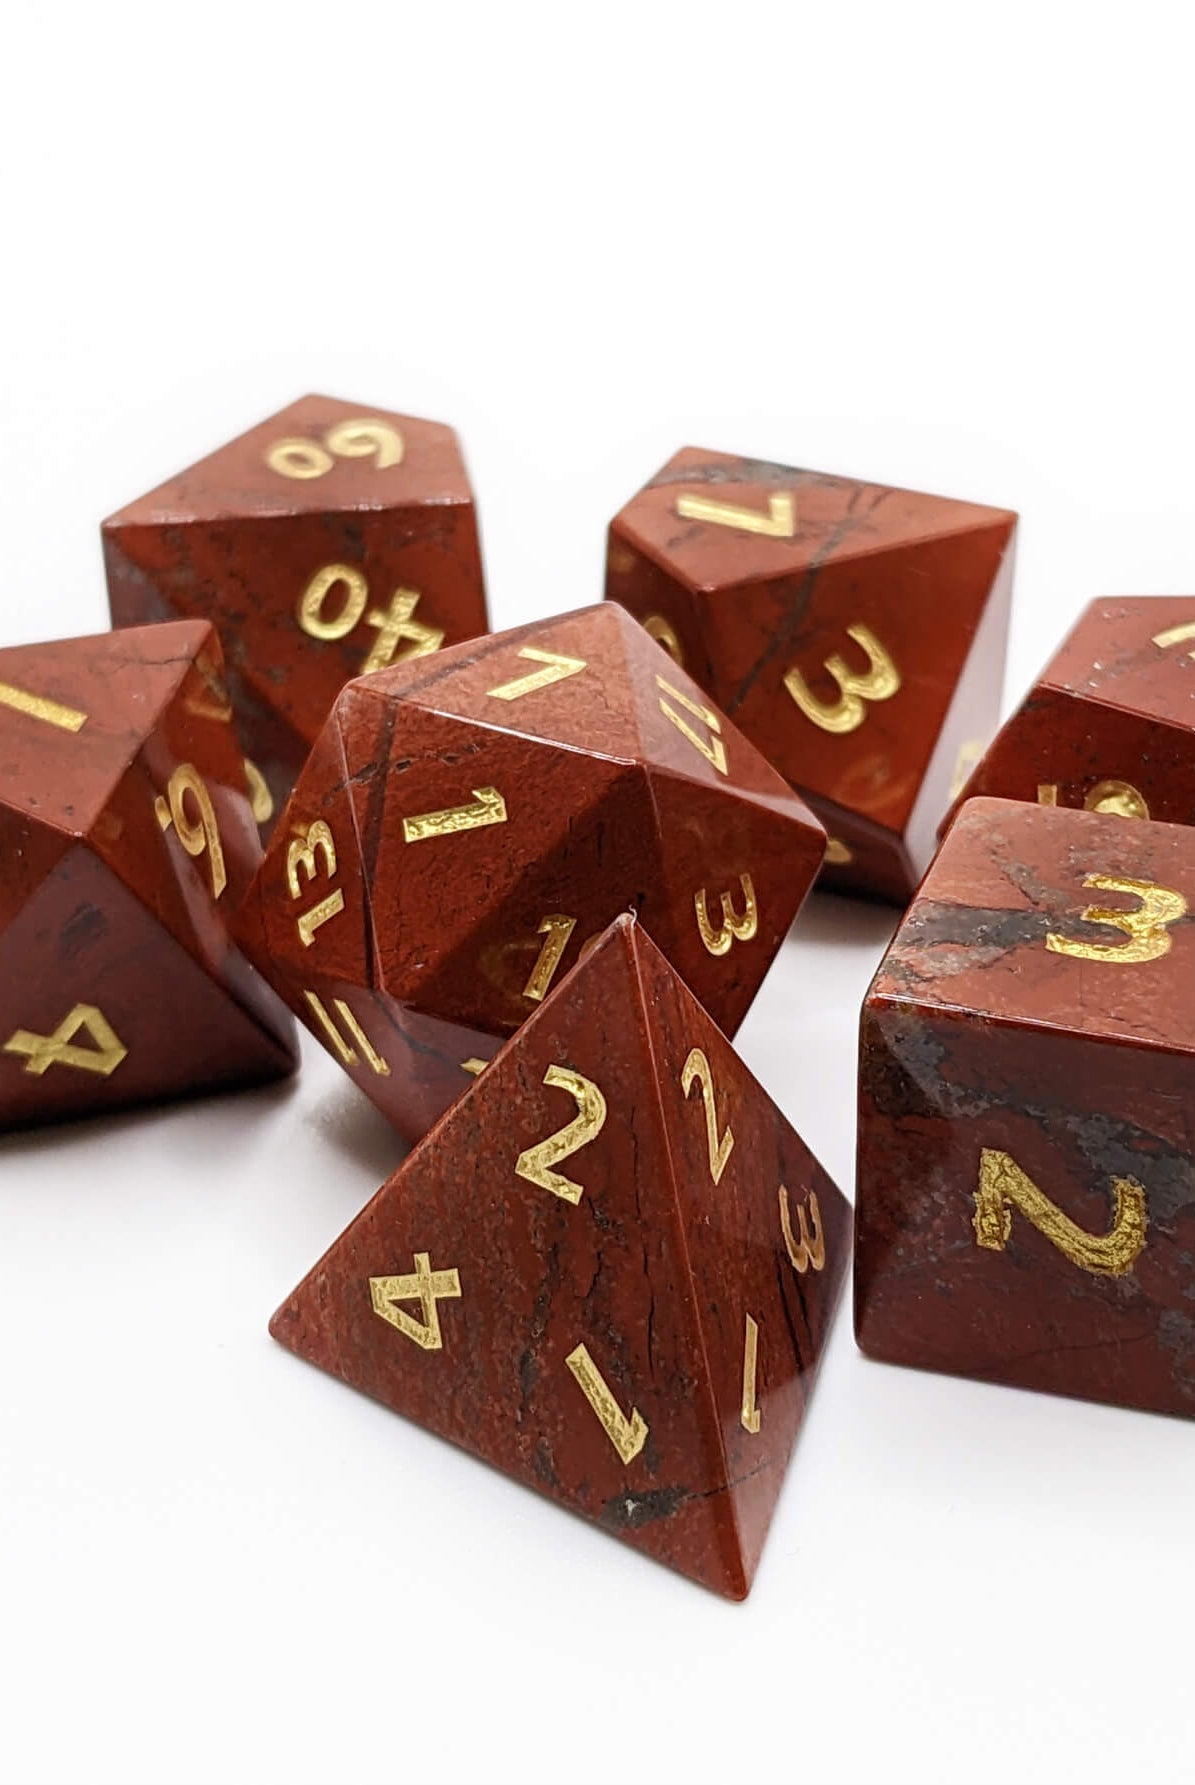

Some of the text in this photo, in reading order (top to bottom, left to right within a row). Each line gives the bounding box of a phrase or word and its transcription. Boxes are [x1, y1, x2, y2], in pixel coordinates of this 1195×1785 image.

[264, 418, 404, 480] 60
[677, 492, 795, 538] 7
[298, 563, 444, 676] 40
[486, 646, 588, 701] 7
[784, 624, 900, 734] 3
[655, 674, 729, 777] 17
[403, 786, 508, 844] 1
[286, 819, 345, 947] 13
[694, 873, 758, 957] 3
[1044, 873, 1189, 964] 3
[3, 1003, 128, 1076] 4
[303, 990, 391, 1076] 11
[515, 1064, 607, 1206] 2
[681, 1047, 735, 1186] 2
[778, 1184, 826, 1273] 3
[973, 1147, 1149, 1278] 2
[369, 1252, 462, 1350] 4
[565, 1343, 650, 1465] 1
[740, 1313, 761, 1434] 1
